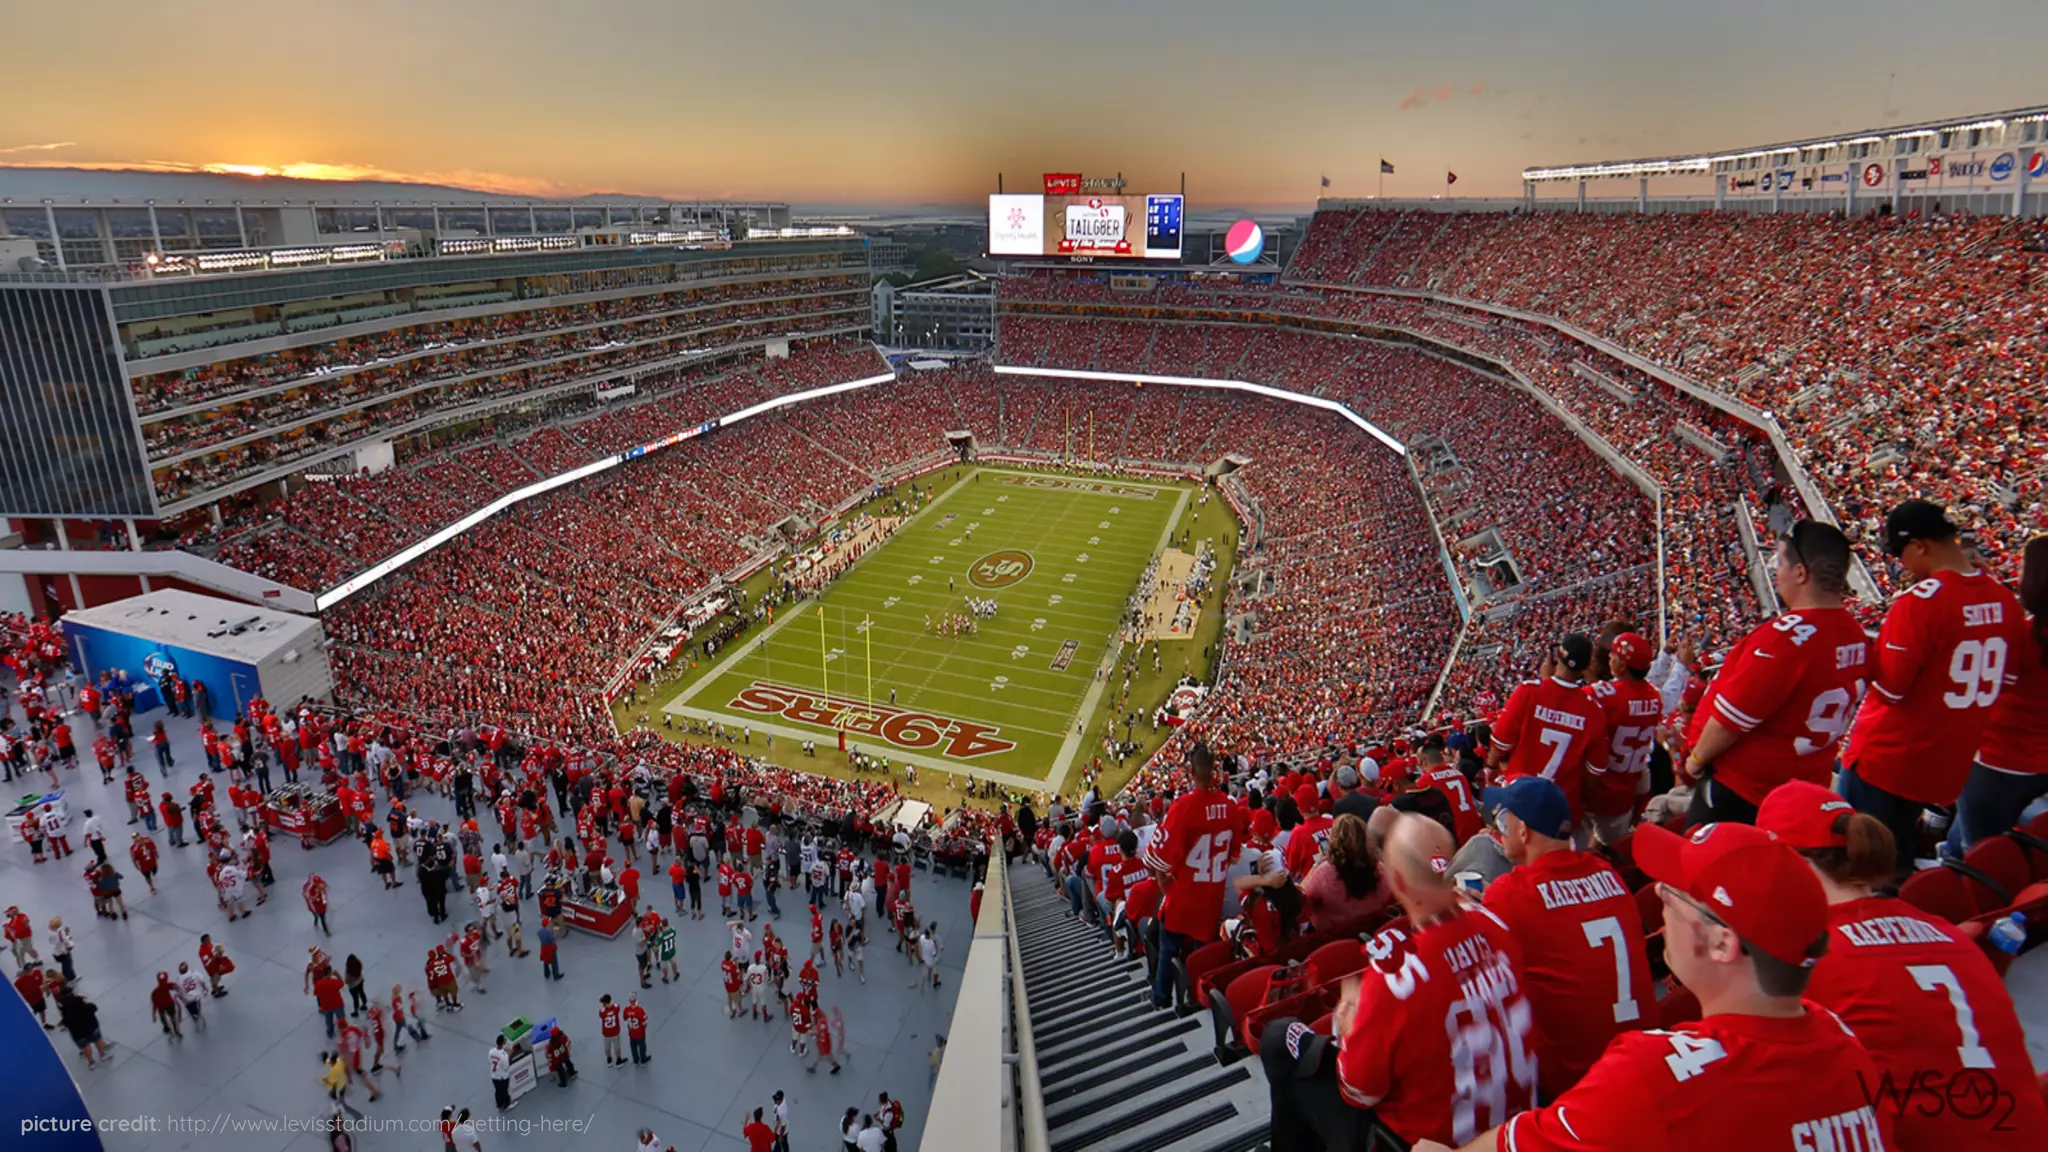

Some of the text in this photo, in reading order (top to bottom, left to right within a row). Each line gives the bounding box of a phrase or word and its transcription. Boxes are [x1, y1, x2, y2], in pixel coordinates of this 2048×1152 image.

[1772, 614, 1818, 646] 94
[152, 657, 174, 670] BUD
[1943, 637, 2007, 708] 99
[726, 683, 1017, 760] 49ERS
[1628, 699, 1660, 716] WILLIS
[1537, 728, 1573, 783] 7
[1609, 726, 1655, 773] 52
[1205, 804, 1228, 821] LOTT
[1446, 780, 1471, 811] 7
[1186, 829, 1233, 883] 42
[1581, 916, 1640, 1023] 7
[604, 1016, 616, 1028] 21
[1905, 964, 1997, 1069] 7
[492, 1060, 499, 1072] 7
[1791, 1104, 1887, 1152] SMITH
